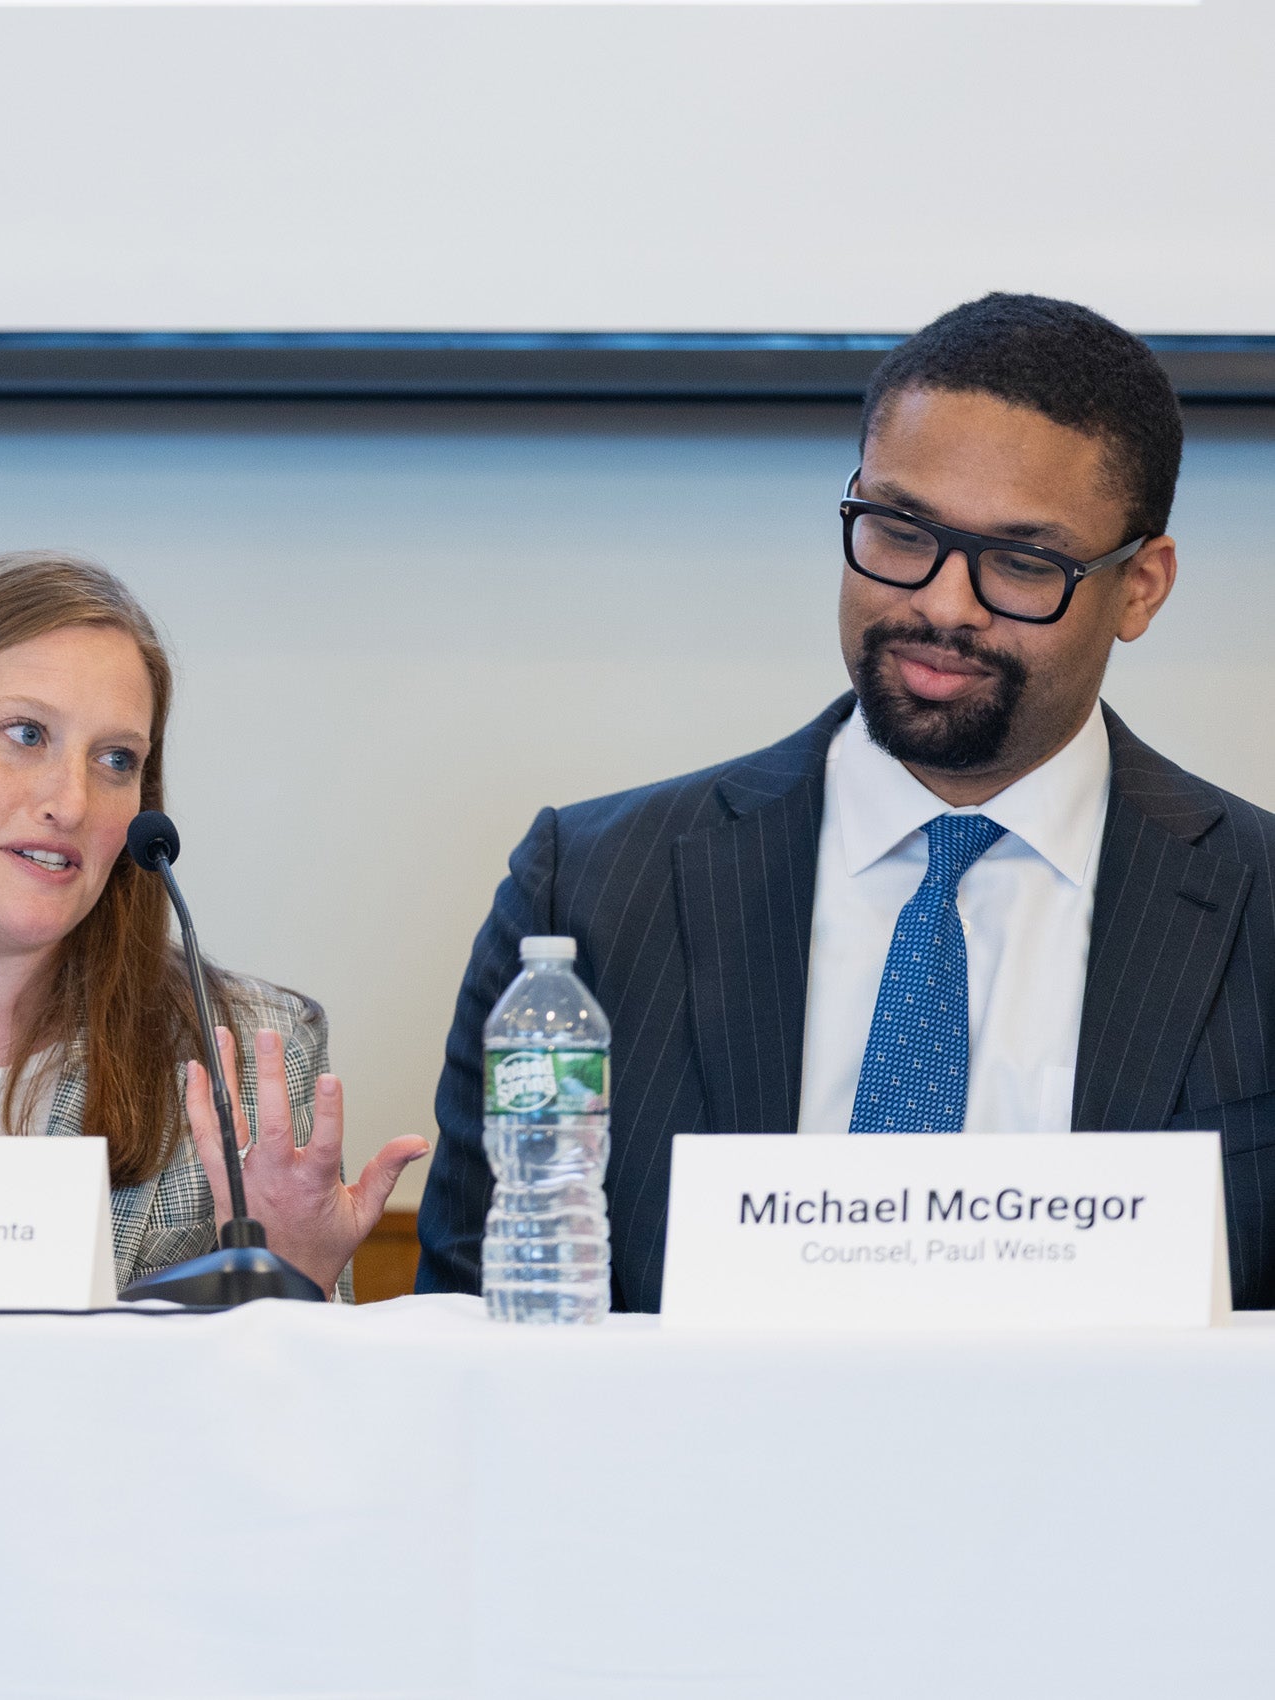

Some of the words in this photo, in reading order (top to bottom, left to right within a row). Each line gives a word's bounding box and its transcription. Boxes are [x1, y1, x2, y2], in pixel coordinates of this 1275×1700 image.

[739, 1188, 910, 1225] Michael
[926, 1187, 1146, 1231] McGregor
[801, 1240, 919, 1267] Counsel,
[925, 1238, 986, 1261] Paul
[994, 1238, 1076, 1260] Weiss
